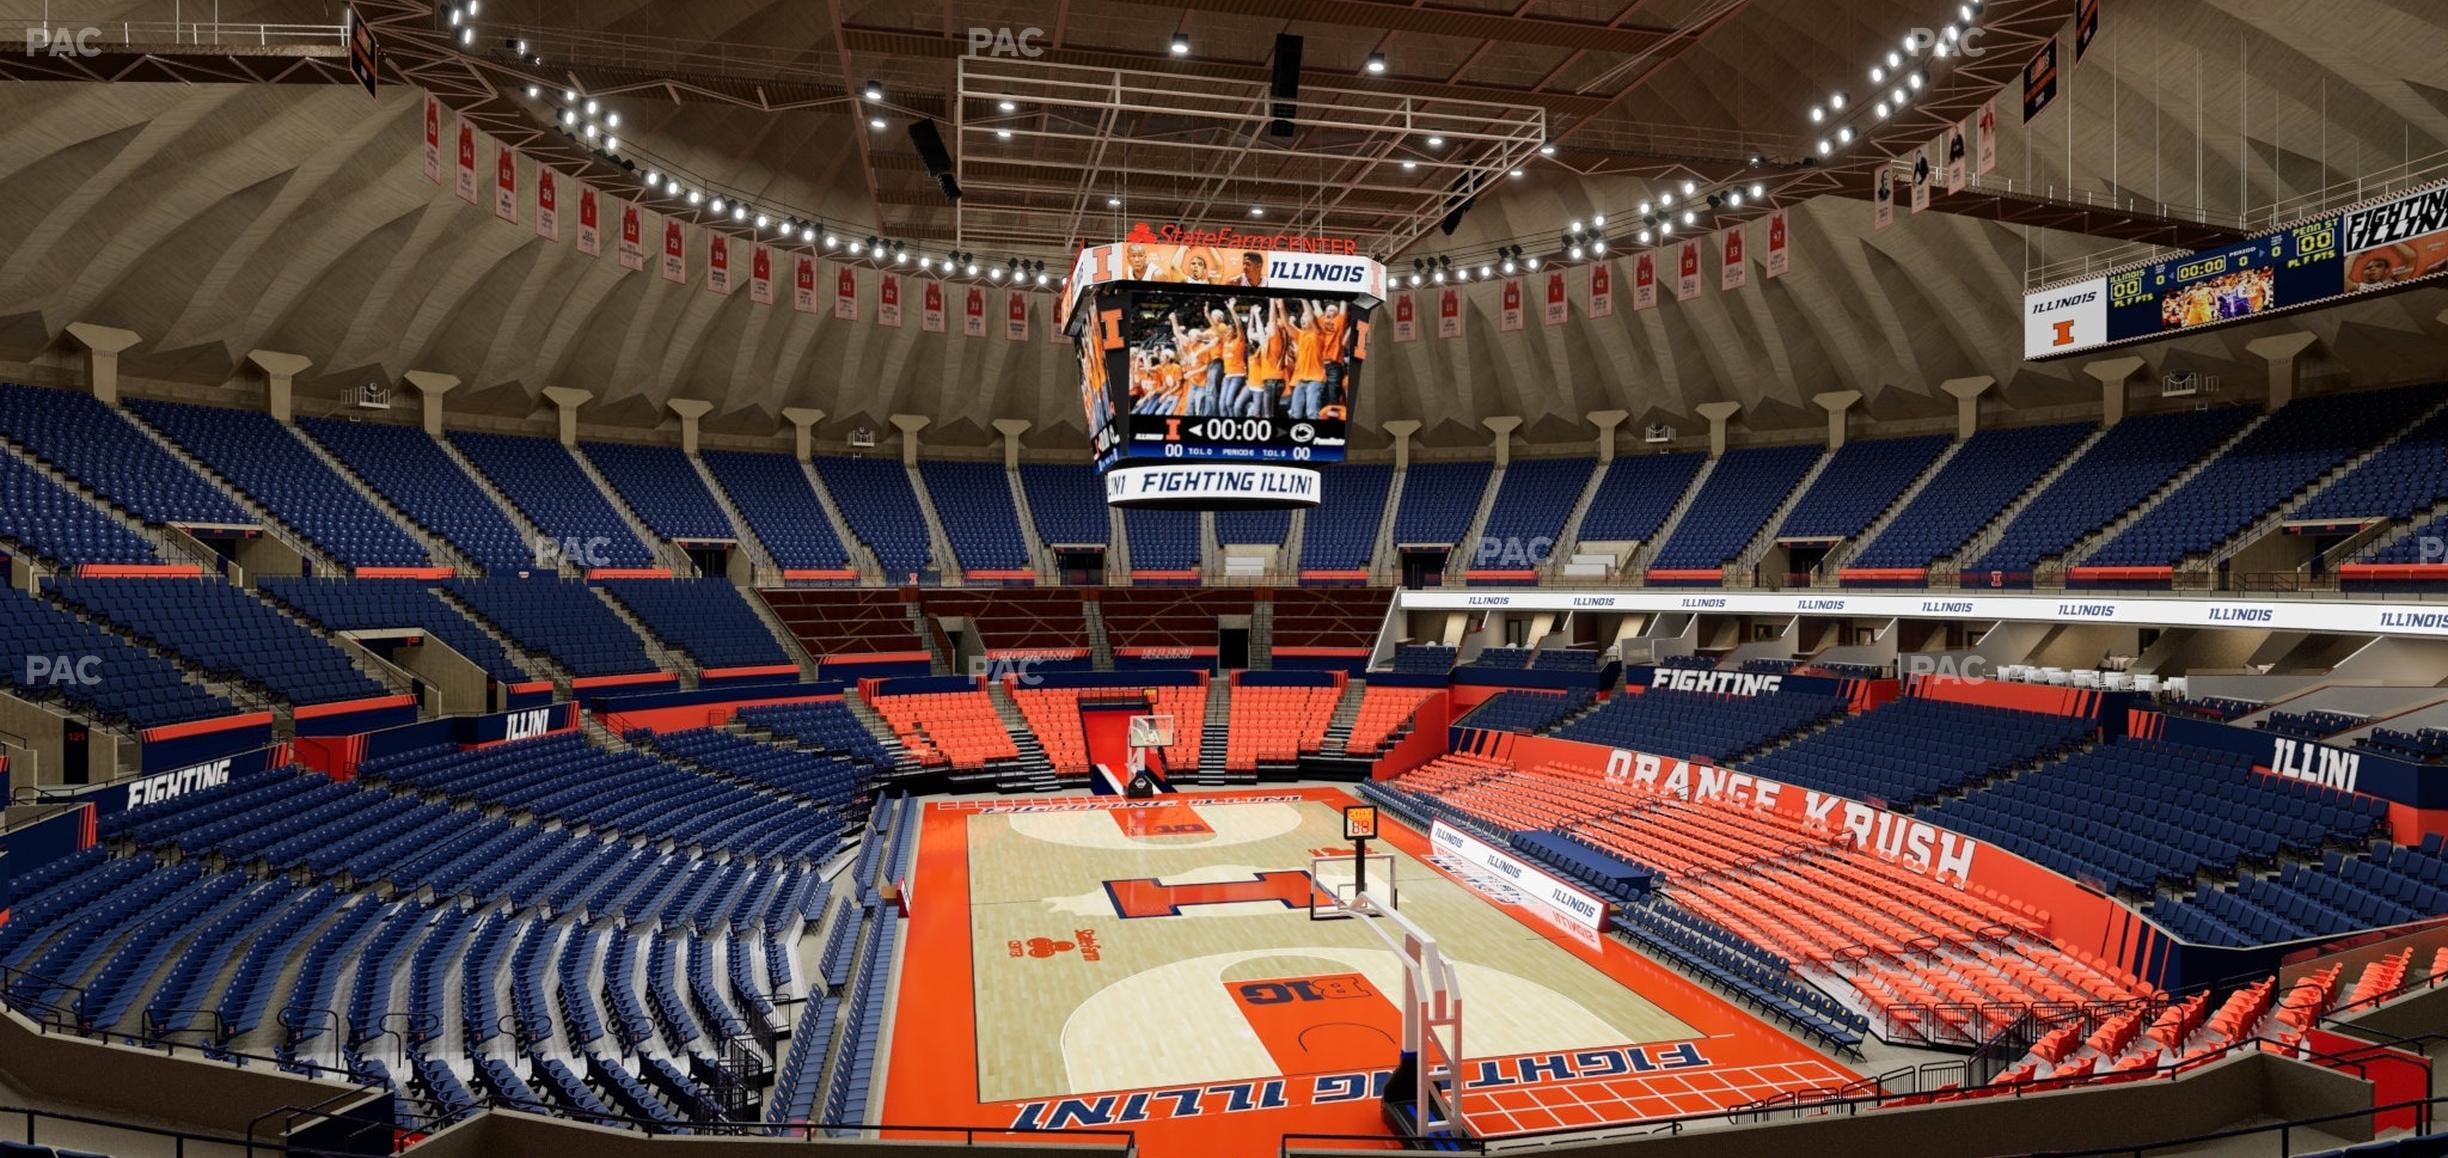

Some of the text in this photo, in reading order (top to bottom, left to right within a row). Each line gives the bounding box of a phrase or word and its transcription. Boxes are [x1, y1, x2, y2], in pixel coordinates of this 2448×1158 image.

[2348, 188, 2448, 233] FIGHTIN
[2301, 231, 2332, 253] 00
[1270, 261, 1365, 283] ILLINOIS
[2179, 259, 2225, 279] 00:00
[2113, 281, 2138, 298] 00
[2032, 291, 2097, 314] ILLINOIS
[1207, 418, 1272, 441] 00:00
[1165, 444, 1183, 457] 00
[1293, 446, 1311, 460] 00
[1141, 471, 1312, 495] FIGHTING ILLINI
[1468, 596, 1510, 605] ILLINOIS
[1573, 597, 1615, 607] ILLINOIS
[1682, 598, 1726, 608] ILLINOIS
[1797, 599, 1845, 610] ILLINOIS
[1921, 601, 1973, 613] ILLINOIS
[2057, 604, 2115, 617] ILLINOIS
[2208, 608, 2273, 622] ILLINOIS
[1652, 668, 1782, 696] FIGHTING
[505, 709, 550, 741] ILLINI
[2271, 737, 2360, 794] ILLINI
[127, 758, 231, 812] FIGHTING
[1604, 748, 1977, 892] ORANGE KRUSH
[1435, 828, 1464, 849] ILLINOIS
[1487, 854, 1522, 879] ILLINOIS
[1552, 888, 1596, 918] ILLINOIS
[1010, 1042, 1713, 1134] FIGHTG ILLINI
